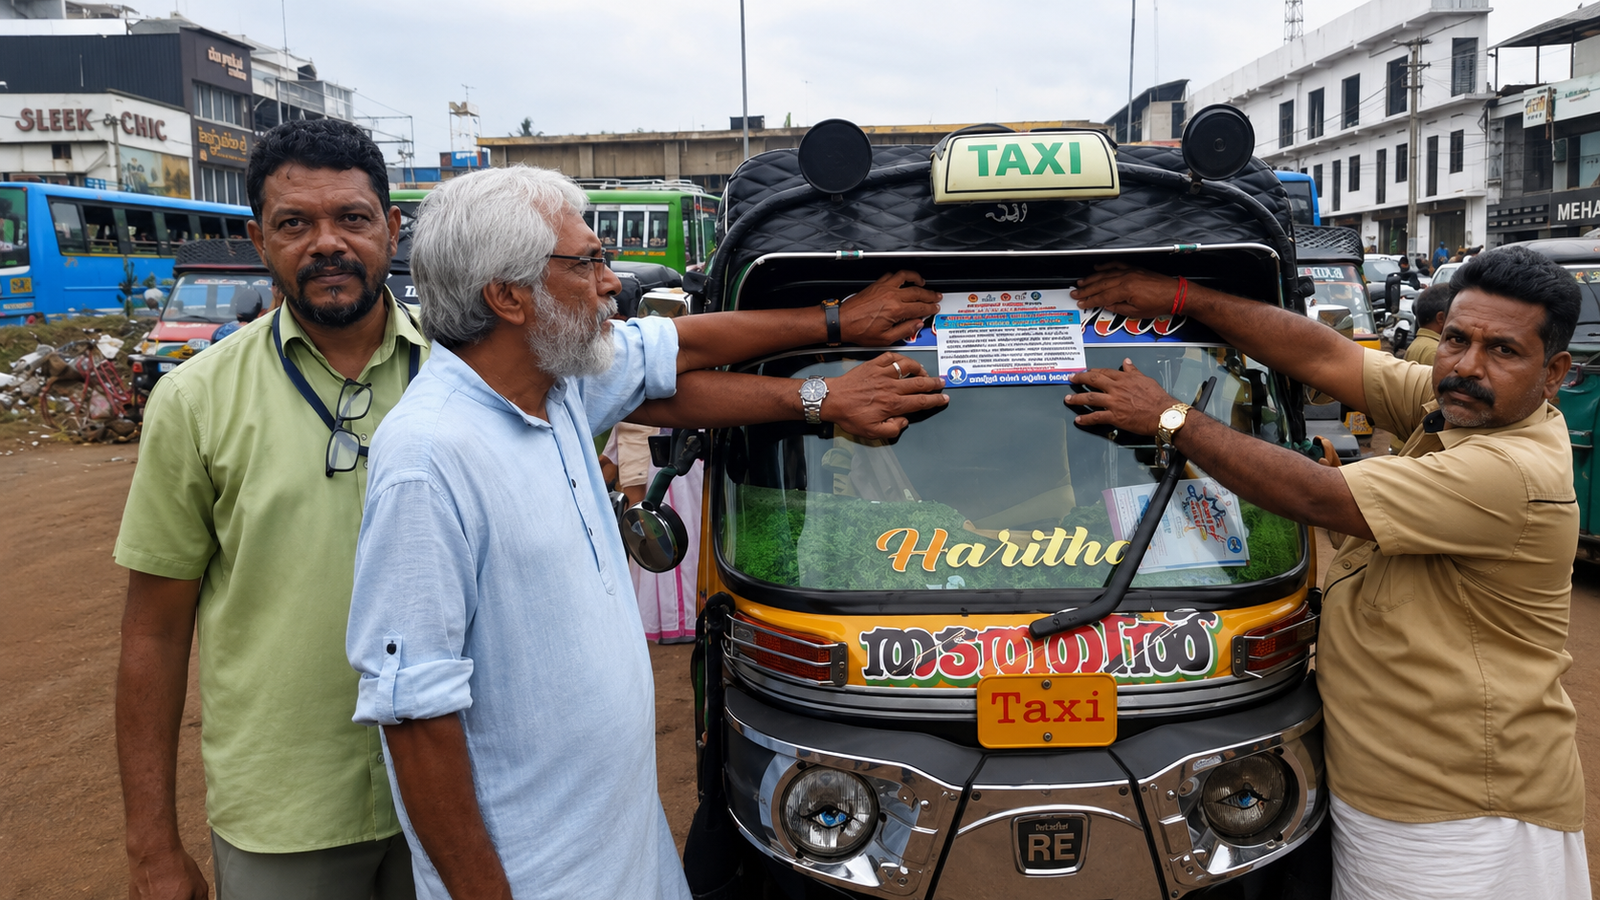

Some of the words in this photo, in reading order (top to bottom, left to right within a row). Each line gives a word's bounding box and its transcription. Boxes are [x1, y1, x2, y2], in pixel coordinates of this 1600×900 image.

[15, 107, 94, 131] SLEEK
[121, 111, 167, 141] CHIC
[968, 142, 1082, 177] TAXI
[991, 690, 1105, 723] Taxi
[1028, 833, 1075, 861] RE
